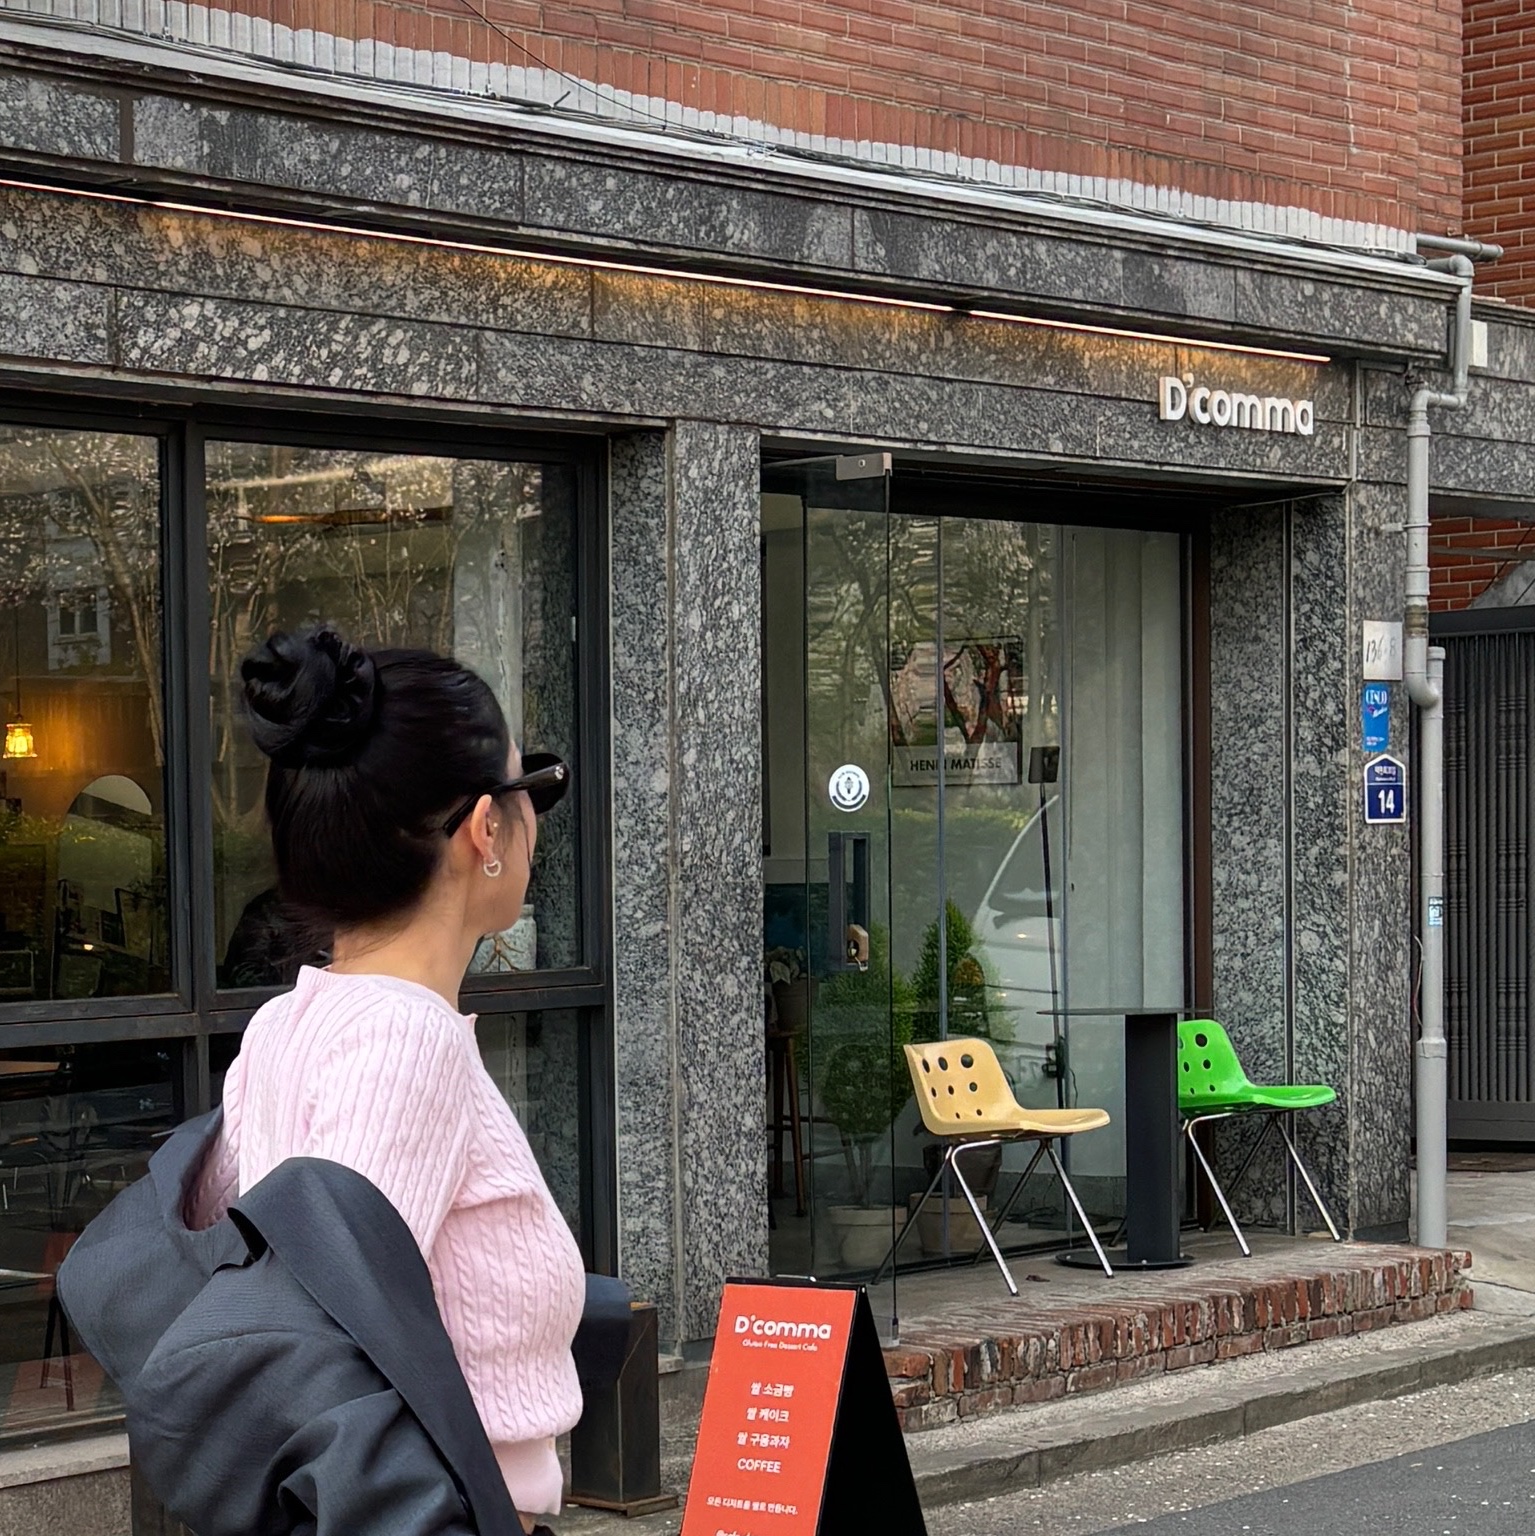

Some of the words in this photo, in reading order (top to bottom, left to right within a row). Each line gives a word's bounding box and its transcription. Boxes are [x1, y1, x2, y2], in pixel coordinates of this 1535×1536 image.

[1159, 373, 1314, 436] D'comma
[910, 759, 947, 771] HENI
[950, 757, 1002, 770] MATISSE
[1378, 789, 1395, 814] 14
[734, 1315, 832, 1340] D'comma
[759, 1408, 790, 1423] 케이크
[737, 1458, 782, 1474] COFFEE
